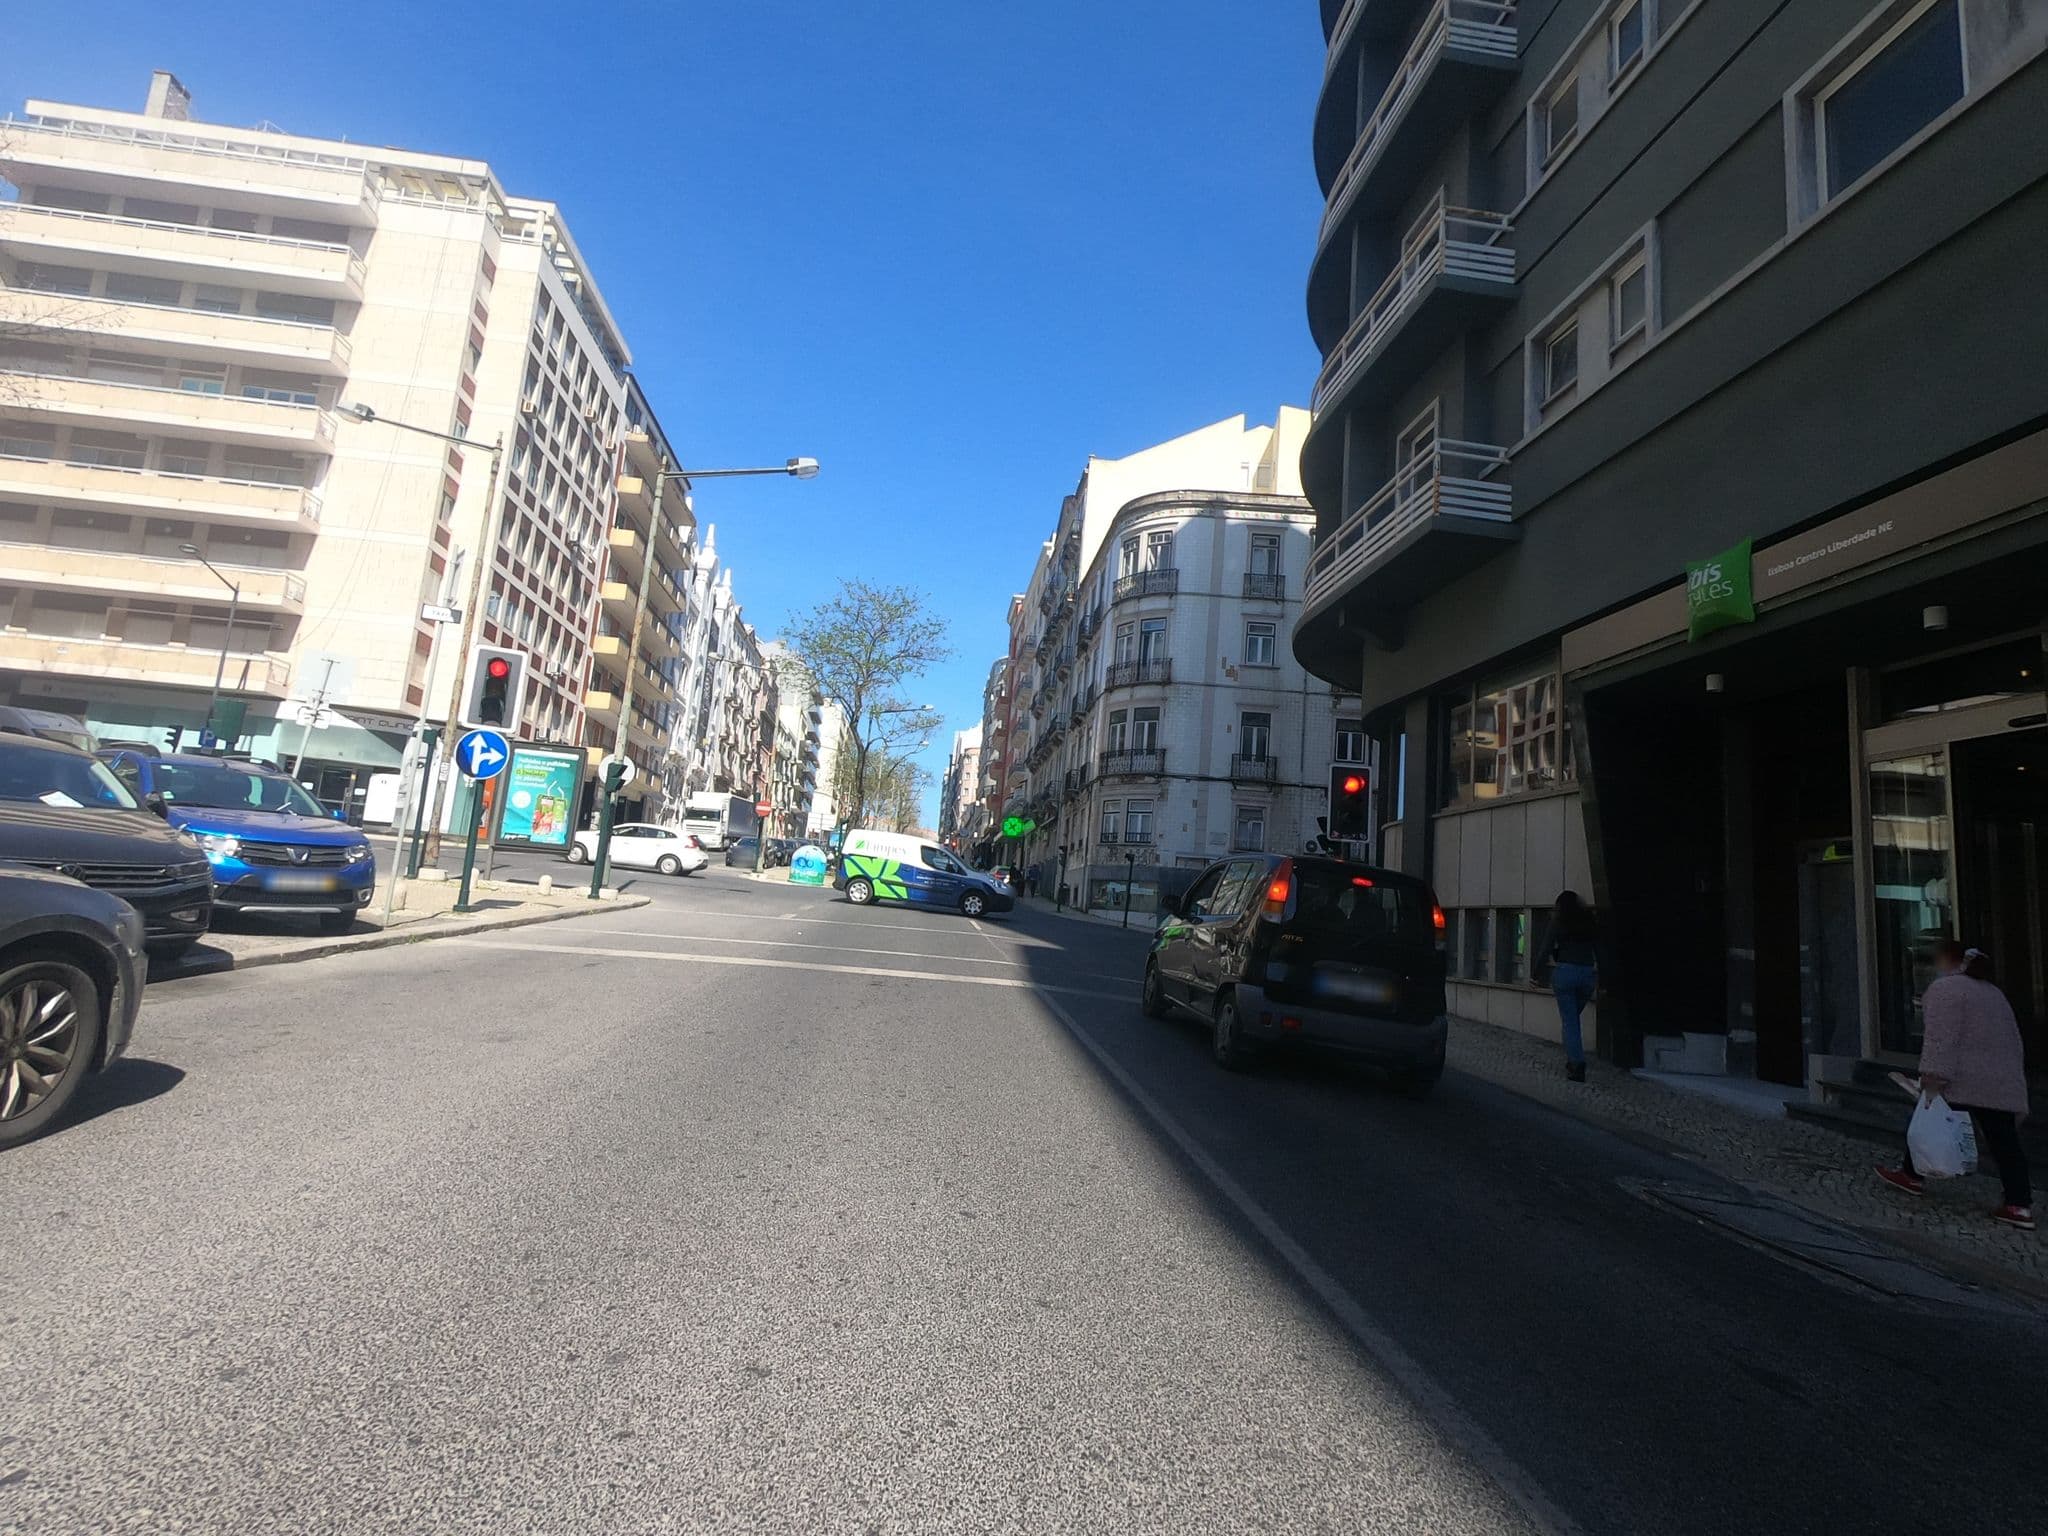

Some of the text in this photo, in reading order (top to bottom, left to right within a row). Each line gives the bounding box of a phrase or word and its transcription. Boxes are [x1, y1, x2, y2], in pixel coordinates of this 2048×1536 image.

[1767, 520, 1894, 577] Lisboa Centro Liberdade NE
[202, 729, 215, 745] P
